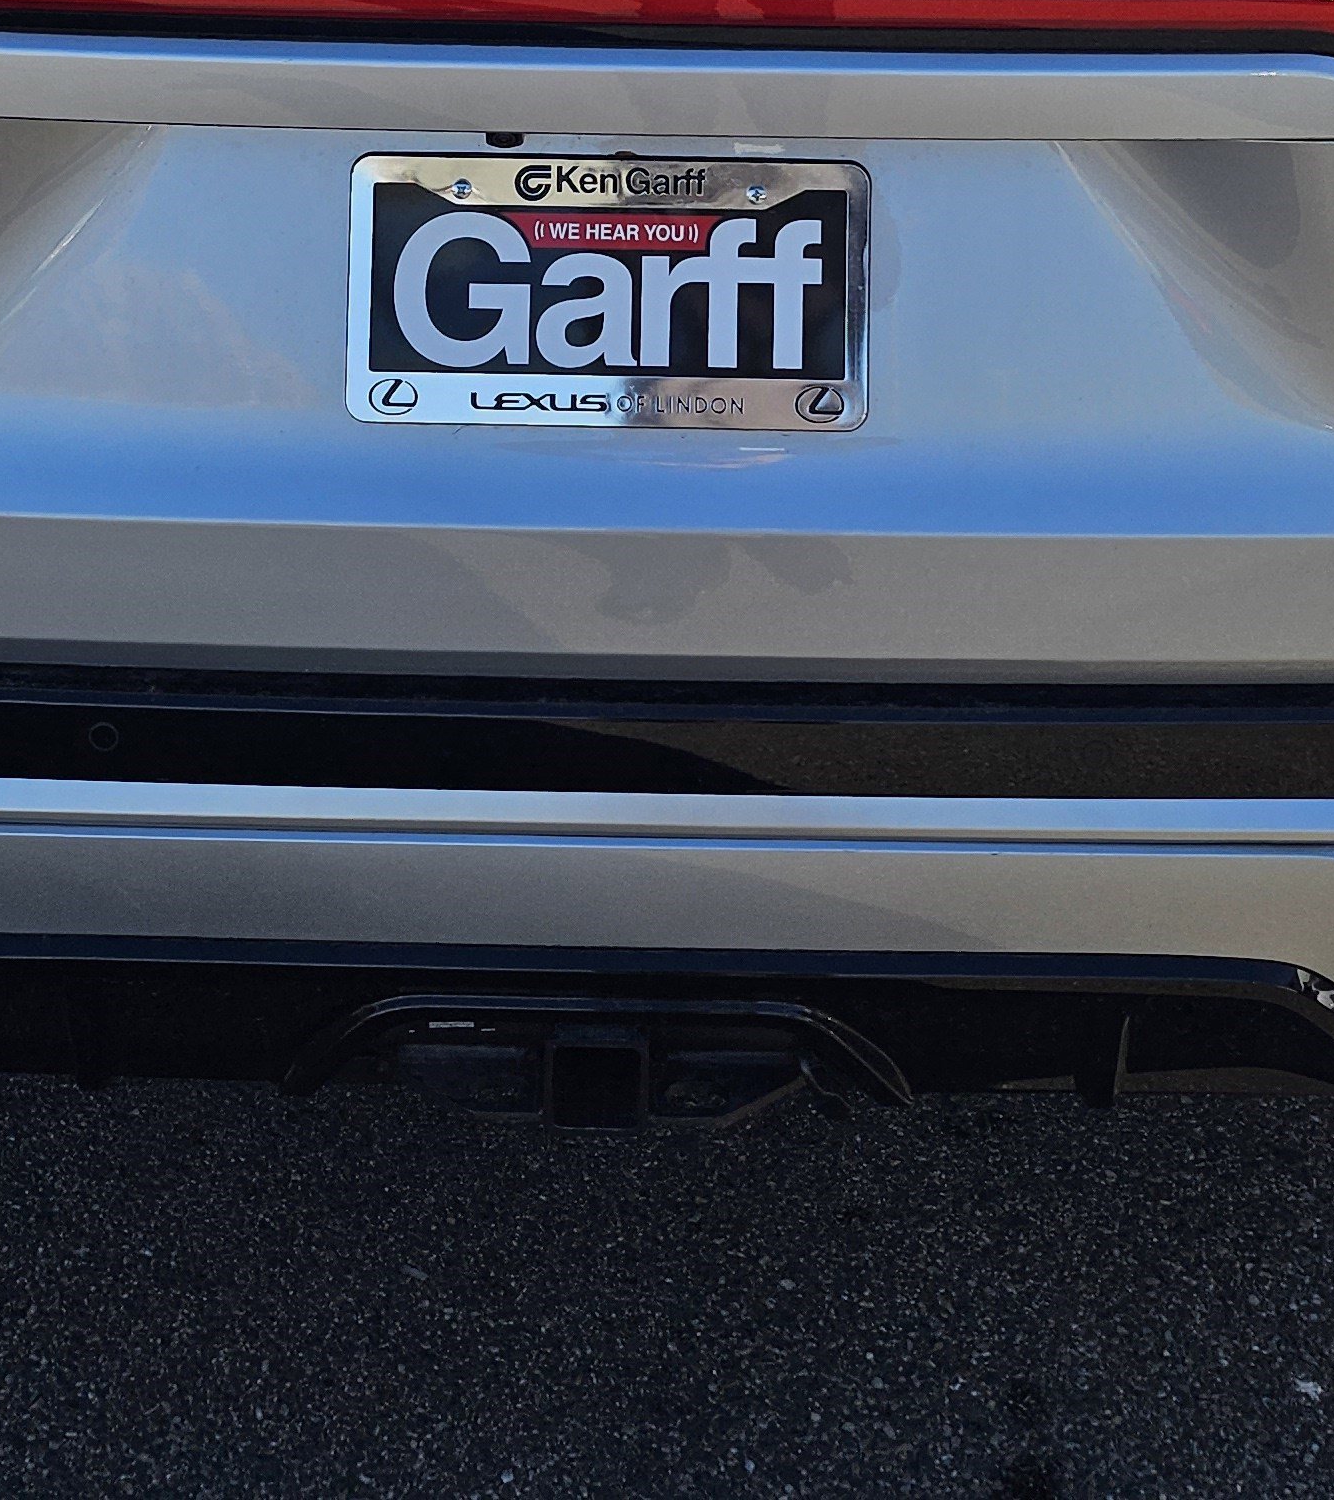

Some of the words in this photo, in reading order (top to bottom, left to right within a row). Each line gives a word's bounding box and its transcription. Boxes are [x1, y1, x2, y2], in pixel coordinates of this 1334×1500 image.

[556, 165, 618, 194] Ken
[625, 167, 707, 196] Garff
[549, 222, 581, 240] WE
[585, 223, 640, 241] HEAR
[644, 224, 685, 242] YOU
[393, 211, 823, 370] Garff
[470, 391, 608, 413] LEXUS
[617, 395, 646, 413] OF
[655, 395, 746, 415] LINDON
